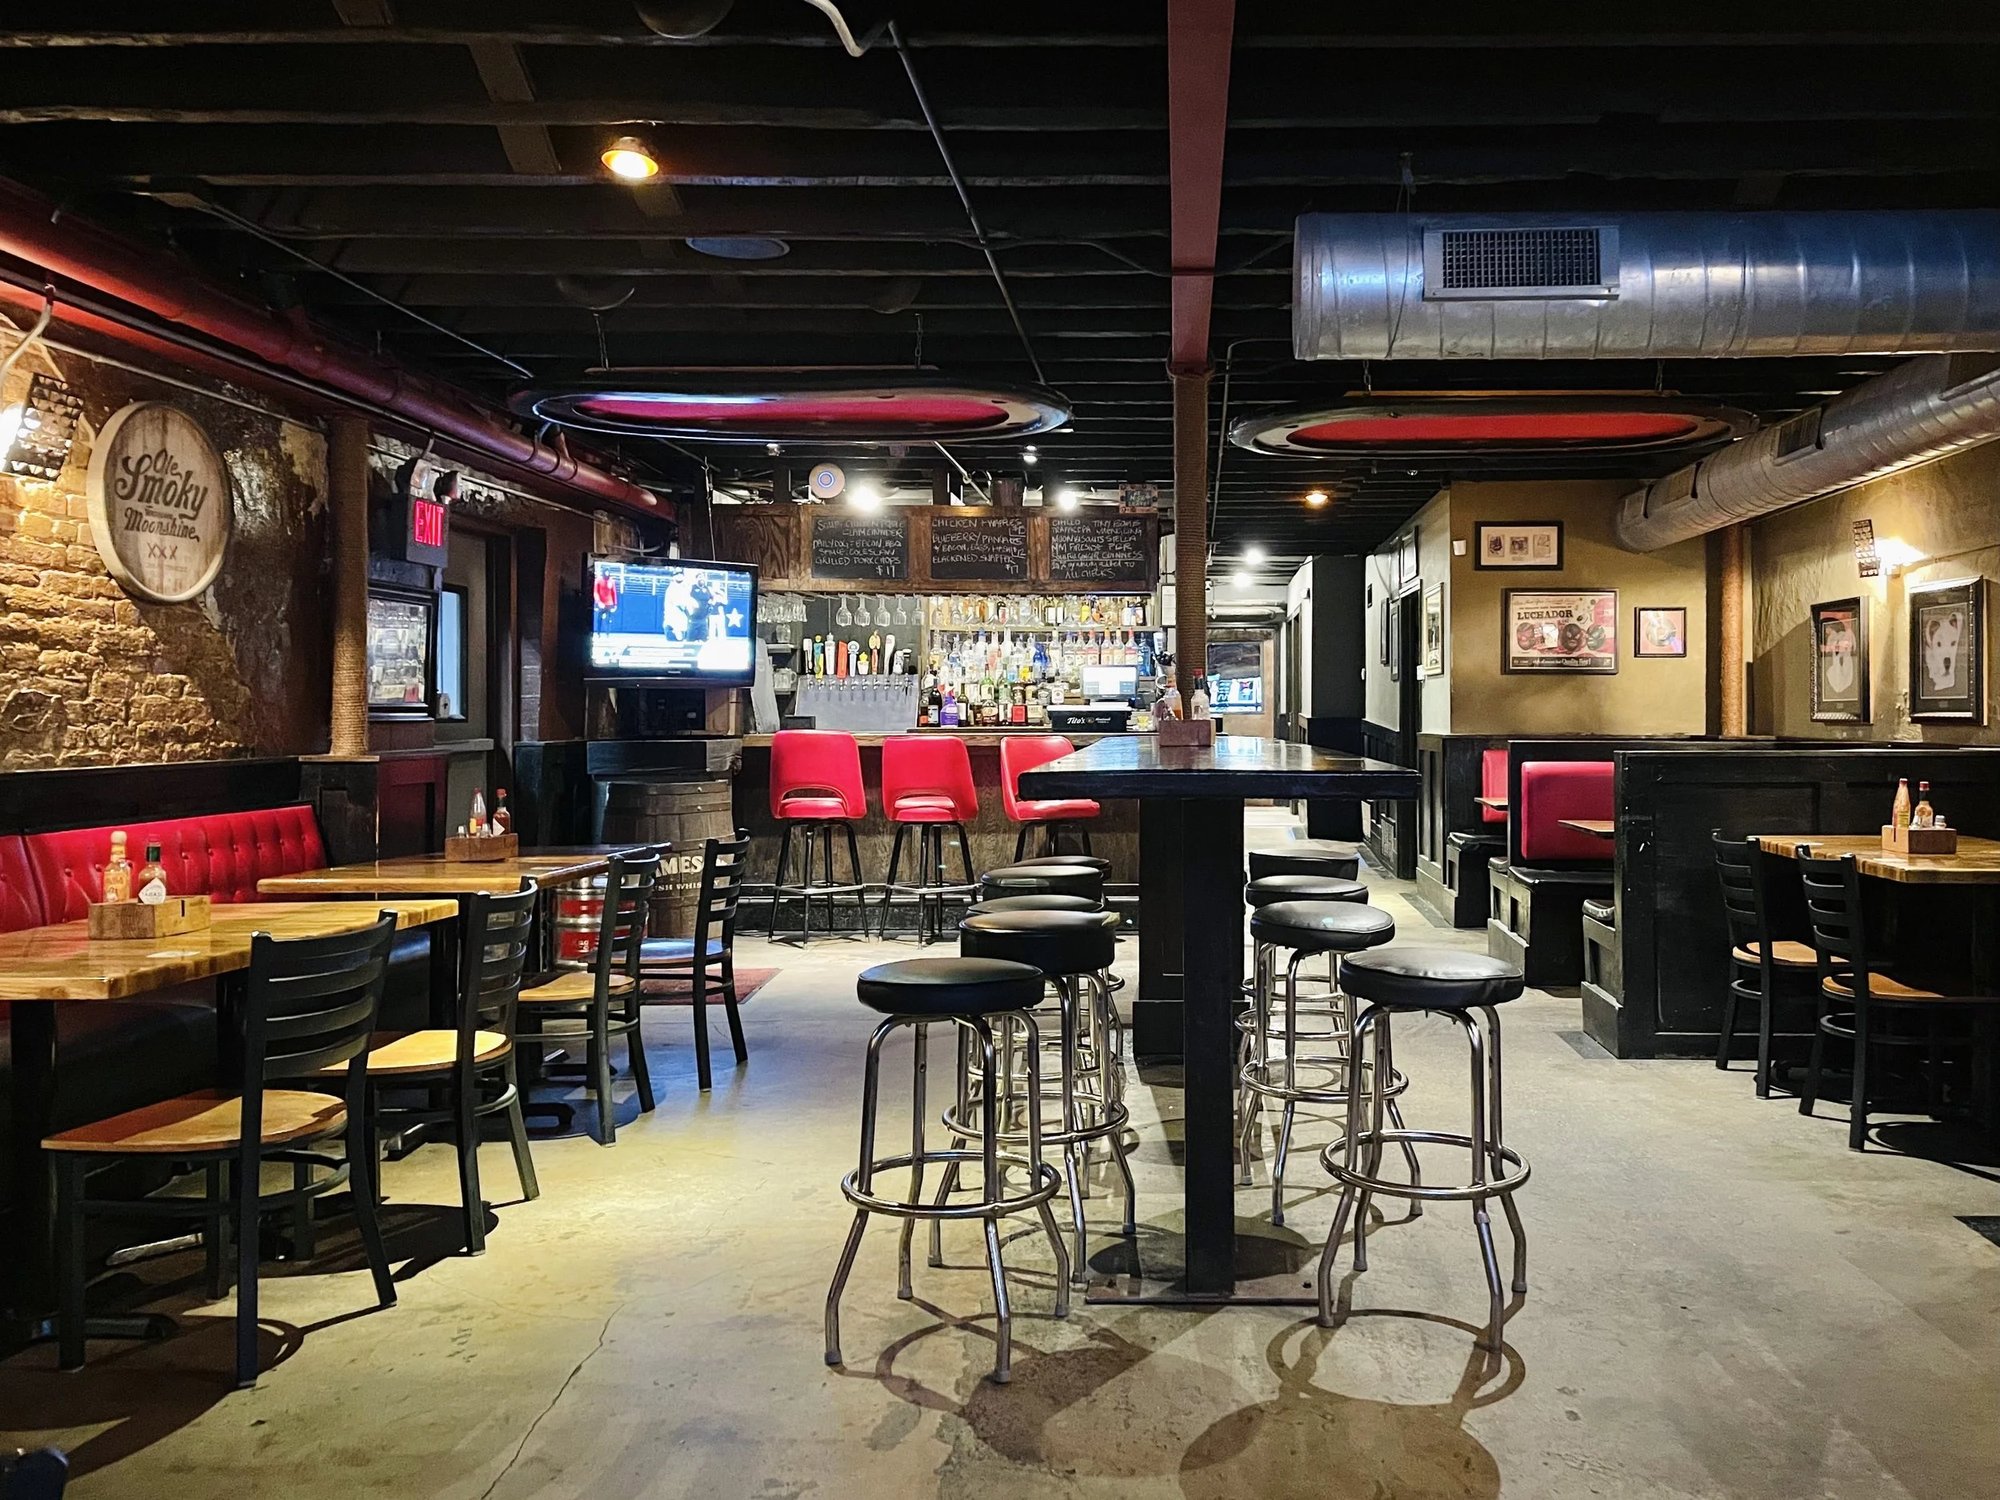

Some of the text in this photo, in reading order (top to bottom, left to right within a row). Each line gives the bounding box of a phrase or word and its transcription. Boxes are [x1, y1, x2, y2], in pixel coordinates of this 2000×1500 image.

[153, 448, 182, 479] Ole
[114, 453, 208, 520] Smoky
[124, 507, 200, 542] Moonshine
[415, 500, 444, 547] EXIT
[931, 518, 978, 528] CHICKEN
[147, 542, 178, 560] XXX
[1517, 609, 1573, 620] LUCHADOR
[1066, 716, 1086, 725] Tito's
